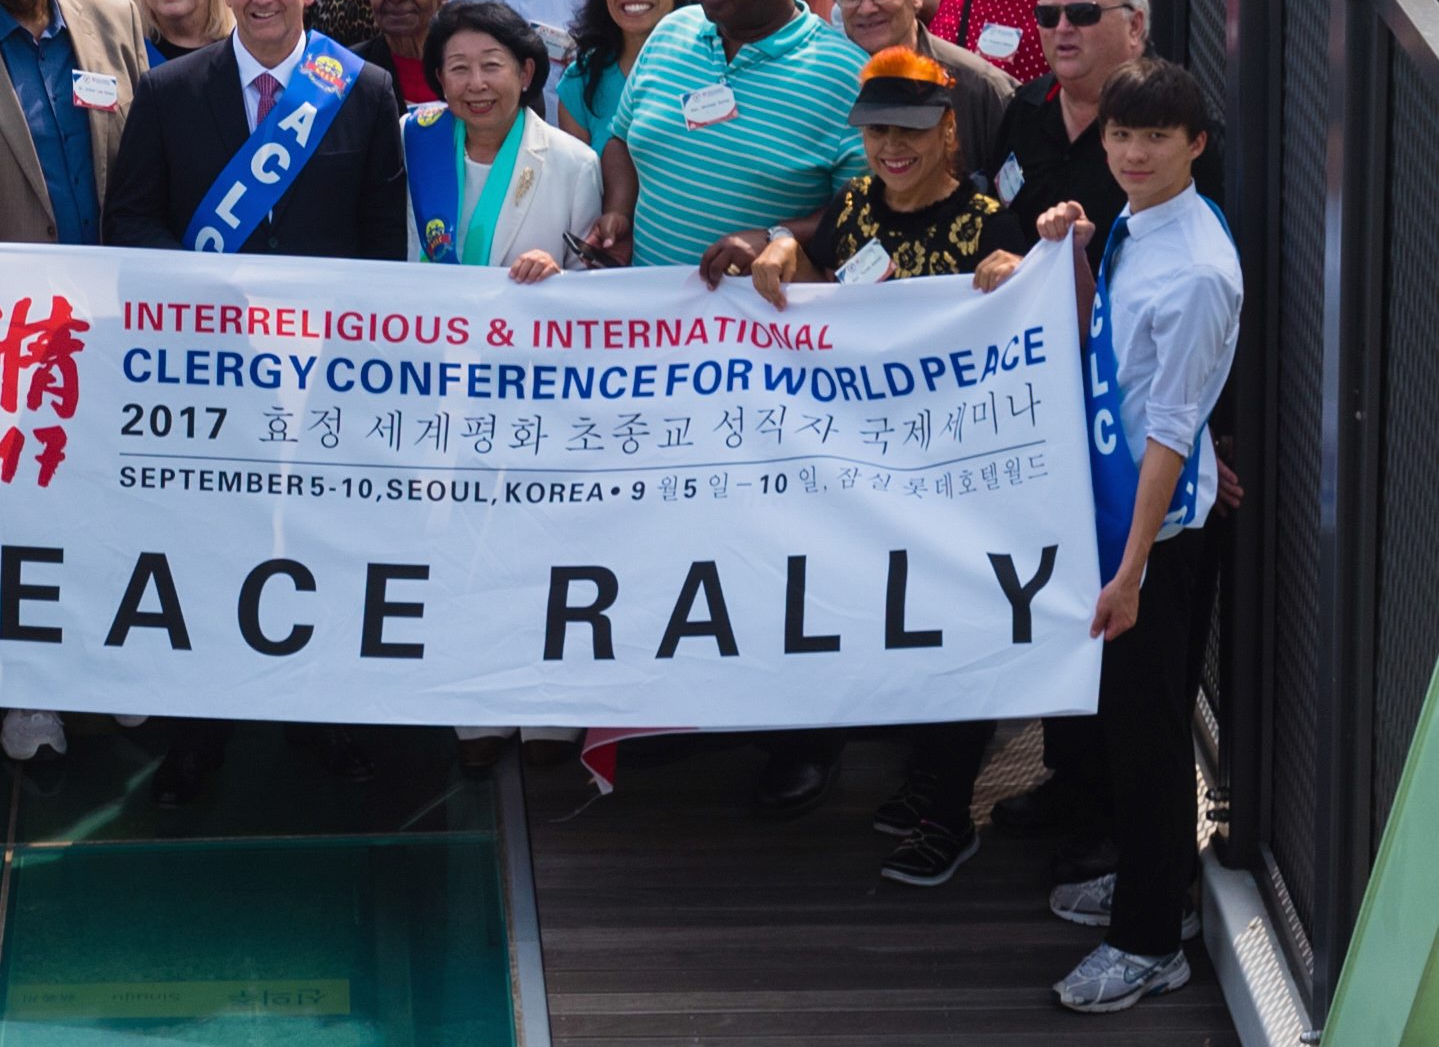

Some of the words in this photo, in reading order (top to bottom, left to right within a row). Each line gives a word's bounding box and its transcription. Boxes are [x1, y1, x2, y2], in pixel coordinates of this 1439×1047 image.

[123, 301, 470, 345] INTERRELIGIOUS
[486, 319, 514, 346] &
[532, 315, 833, 351] INTERNATIONAL
[1089, 263, 1117, 456] CLC
[123, 348, 317, 390] CLERGY
[326, 357, 658, 400] CONFERENCE
[664, 359, 753, 397] FOR
[763, 362, 916, 403] WORLD
[919, 326, 1047, 393] PEACE
[120, 403, 228, 440] 2017
[258, 405, 342, 449] 효정
[365, 408, 549, 456] 세계평화
[565, 413, 695, 455] 초종교
[712, 405, 840, 449] 성직자
[859, 381, 1043, 456] 국제세미나
[119, 466, 304, 497] SEPTEMBER
[543, 543, 1060, 662] RALLY
